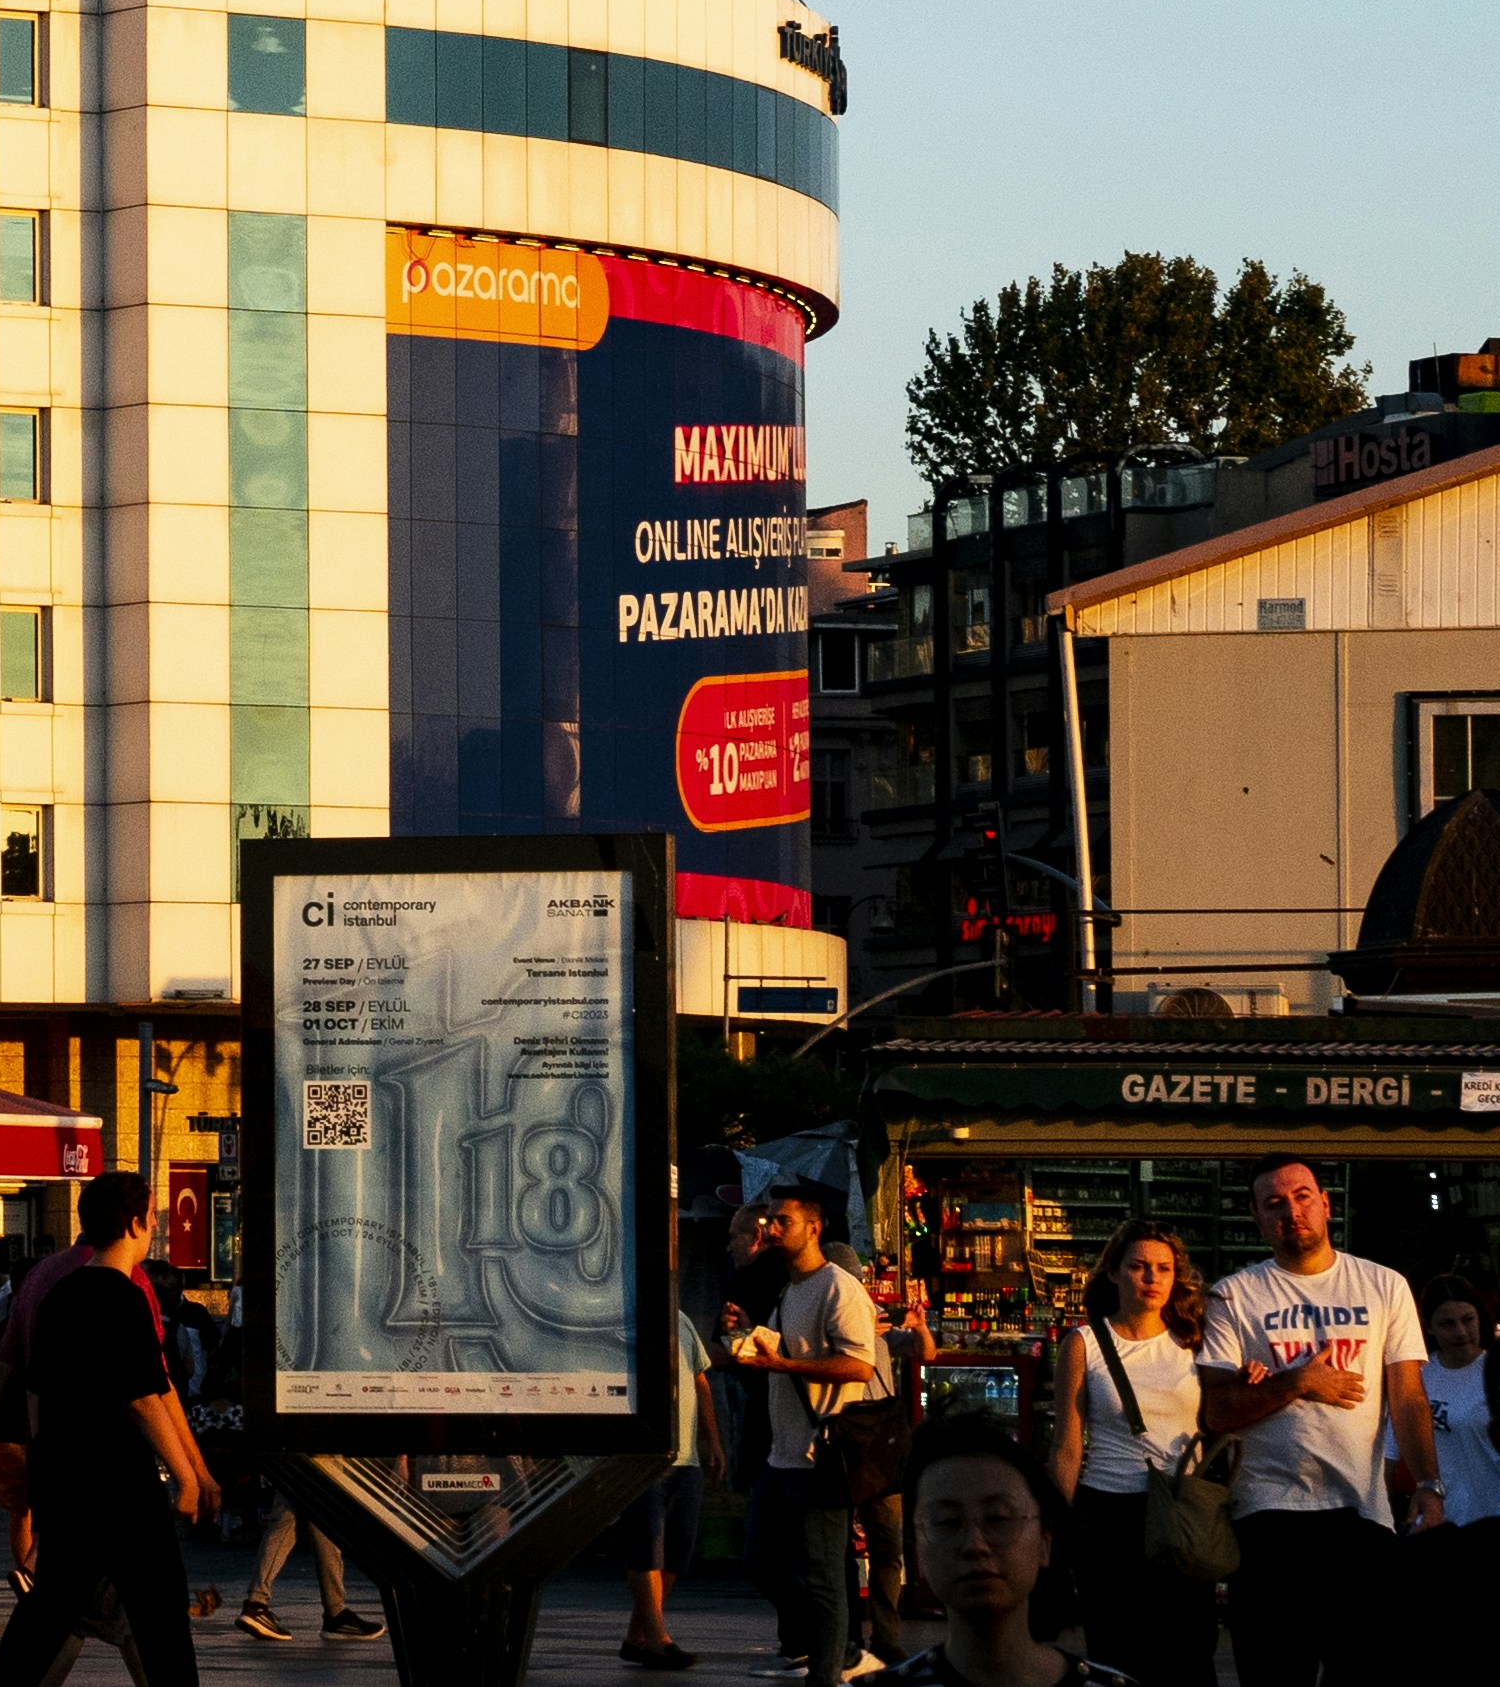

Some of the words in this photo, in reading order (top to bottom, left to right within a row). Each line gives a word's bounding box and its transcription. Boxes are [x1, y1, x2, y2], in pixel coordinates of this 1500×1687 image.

[402, 258, 581, 309] pazarama
[635, 519, 721, 563] ONLINE
[726, 505, 791, 569] ALIŞVERİŞ
[619, 587, 785, 642] PAZARAMA'DA
[302, 892, 335, 927] ci
[343, 899, 436, 913] contemporary
[547, 898, 615, 908] AKBANK
[343, 914, 397, 926] istanbul
[302, 958, 320, 969] 27
[324, 958, 355, 970] SEP
[366, 955, 409, 969] EYLÜL
[526, 968, 566, 977] Tersane
[302, 1001, 321, 1012] 28
[325, 1001, 356, 1012] SEP
[368, 997, 411, 1012] EYLÜL
[481, 997, 609, 1007] contemporaryistanbul.com
[302, 1019, 320, 1030] 01
[324, 1019, 358, 1030] OCT
[370, 1016, 404, 1030] EKİM
[1122, 1074, 1256, 1104] GAZETE
[1306, 1074, 1410, 1105] DERGİ
[1464, 1080, 1492, 1091] KREDİ
